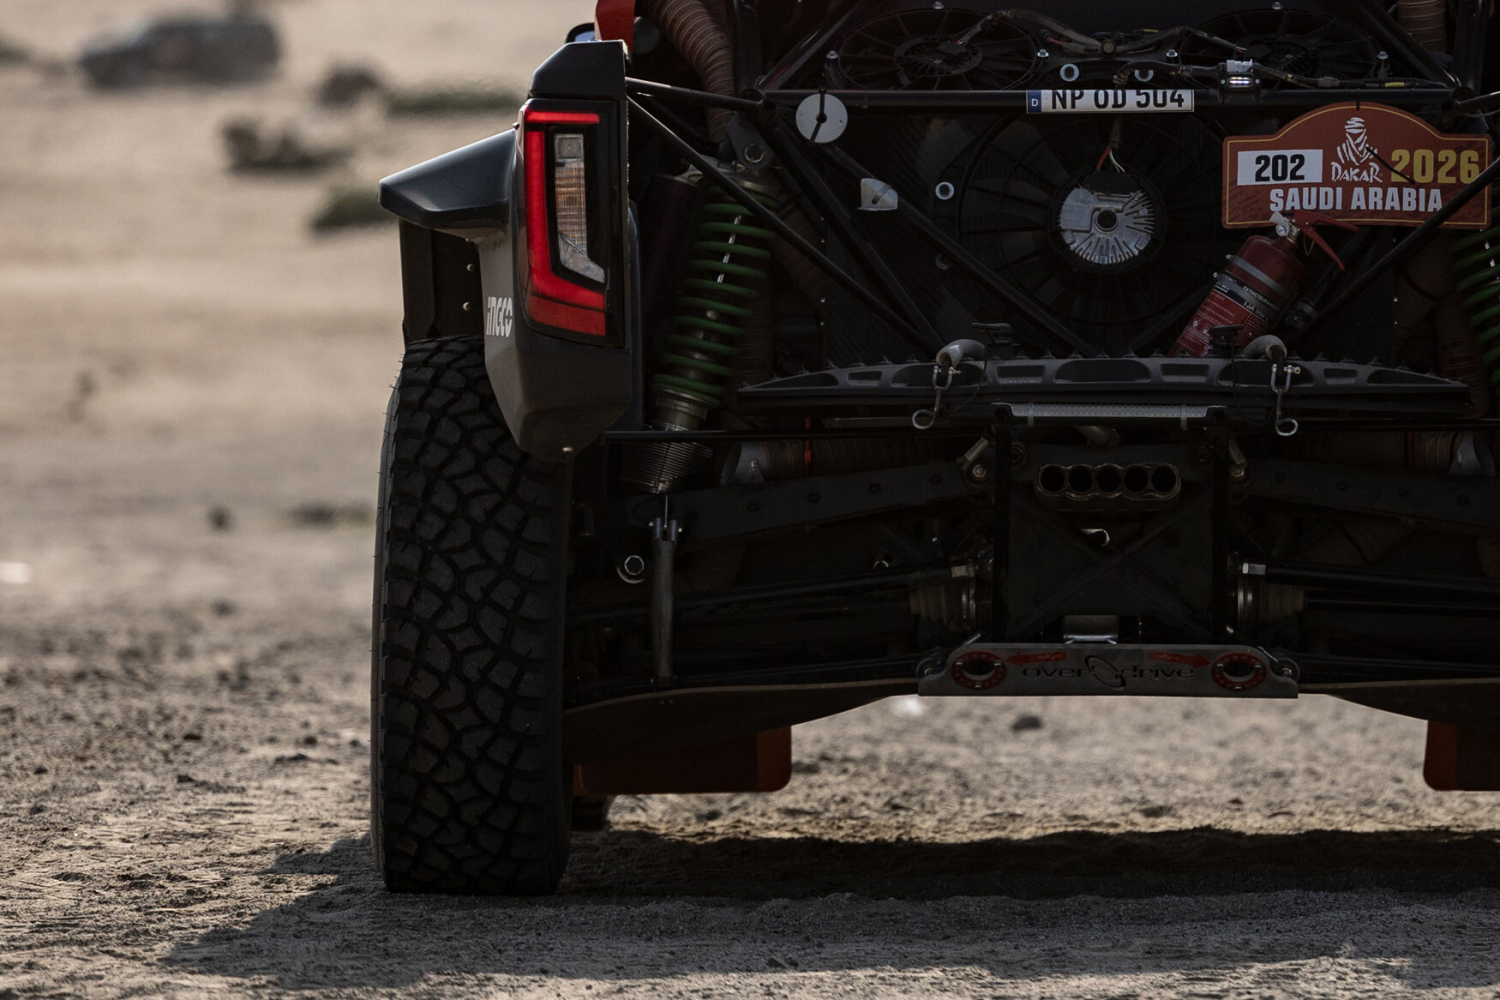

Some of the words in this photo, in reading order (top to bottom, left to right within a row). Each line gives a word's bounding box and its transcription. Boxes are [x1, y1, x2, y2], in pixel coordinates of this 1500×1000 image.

[1031, 98, 1039, 107] D
[1051, 89, 1085, 110] NP
[1136, 89, 1185, 109] 504
[1254, 154, 1306, 182] 202
[1330, 161, 1384, 183] DAKAR
[1390, 149, 1480, 185] 2026
[1269, 187, 1343, 213] SAUDI
[1350, 187, 1443, 213] ARABIA
